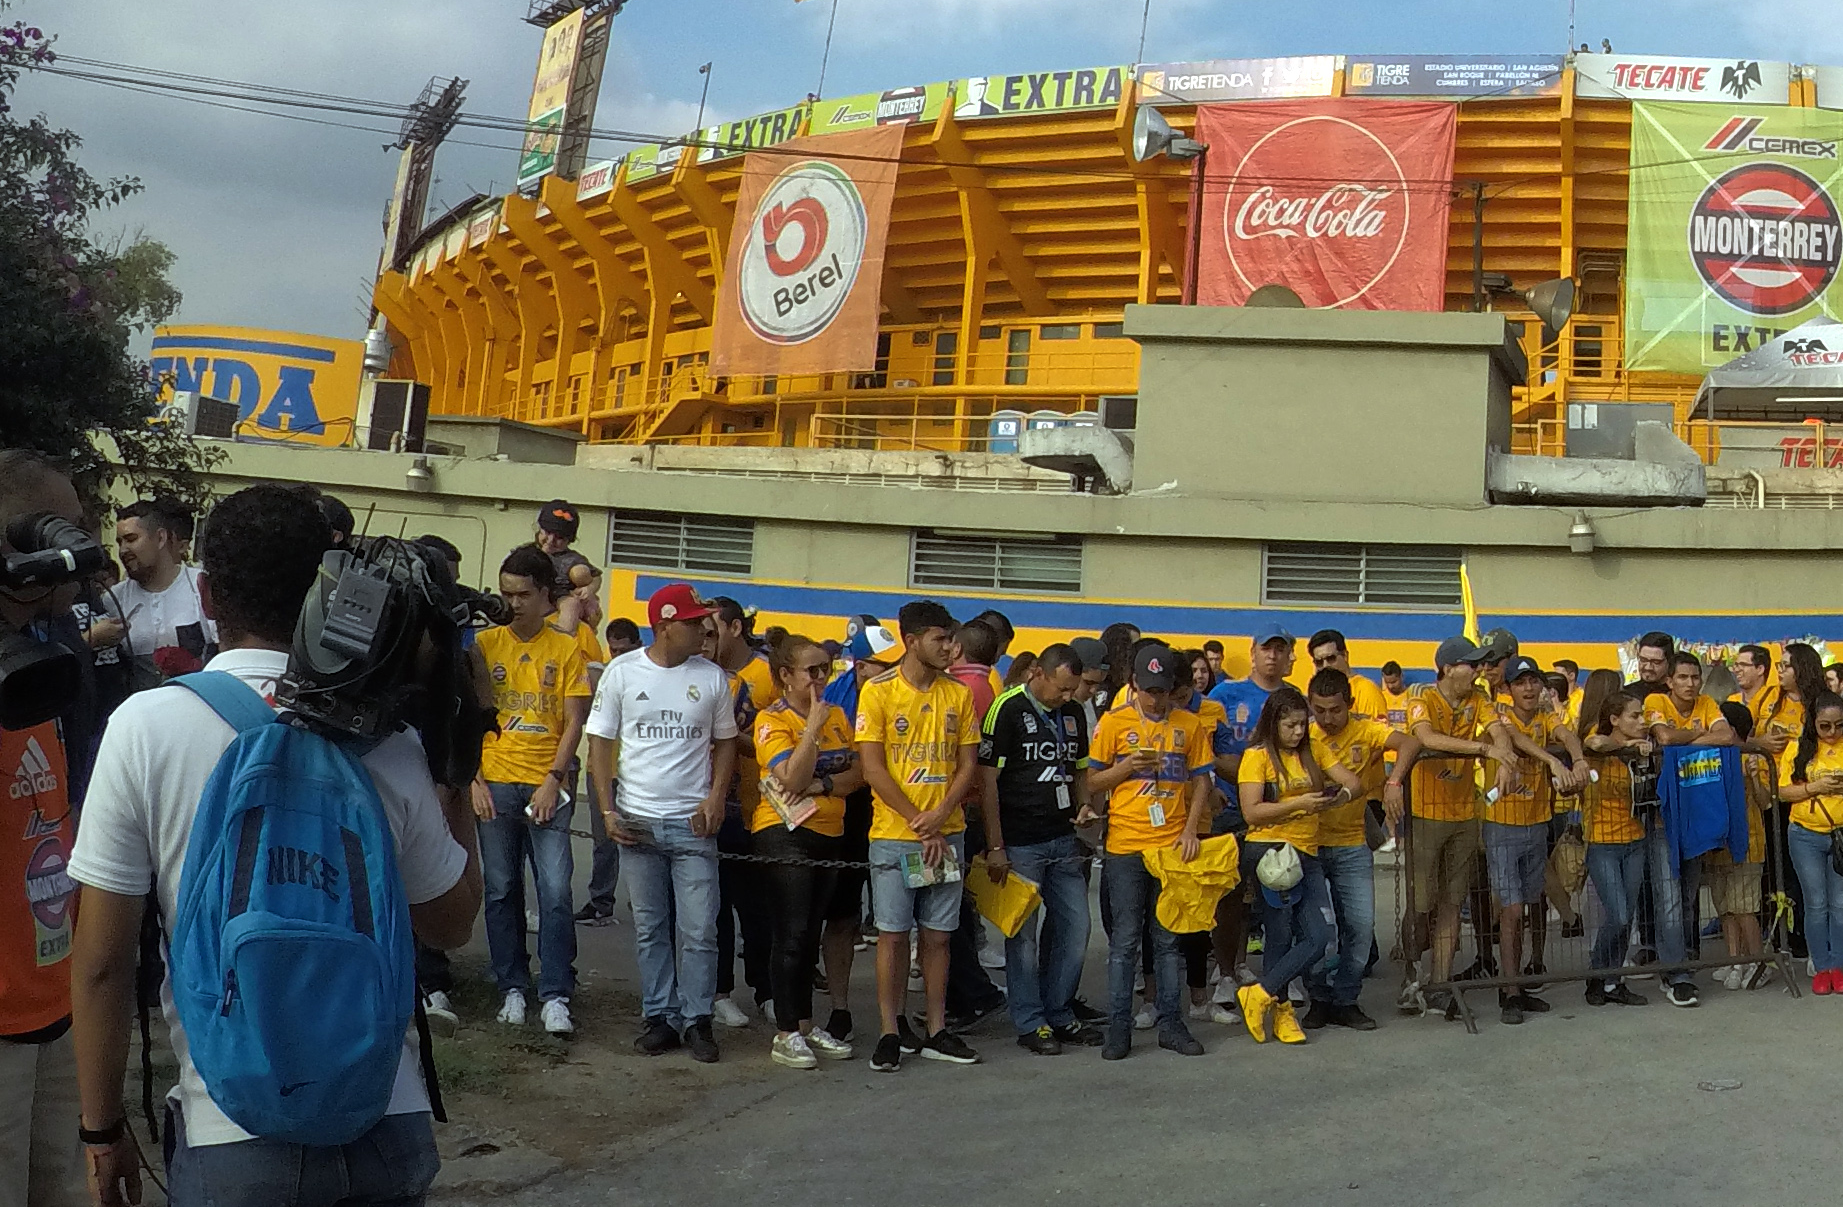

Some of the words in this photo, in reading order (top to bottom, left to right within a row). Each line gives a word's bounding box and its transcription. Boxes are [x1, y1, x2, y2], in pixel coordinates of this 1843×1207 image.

[1168, 72, 1254, 91] TIGRETIENDA
[1376, 64, 1410, 76] TIGRE
[1376, 75, 1410, 86] TIENDA
[1611, 62, 1712, 94] TECATE
[1003, 68, 1122, 111] EXTRA
[876, 96, 925, 119] MONTERREY
[727, 109, 804, 148] EXTRA
[1747, 137, 1837, 159] CEMEX
[1234, 183, 1397, 240] Coca-Cola
[1693, 214, 1840, 262] MONTERREY
[772, 251, 845, 319] Berel
[1712, 323, 1790, 353] EXT
[636, 721, 703, 739] Emirates
[660, 709, 683, 724] Fly
[9, 771, 58, 800] adidas
[267, 844, 341, 903] NIKE
